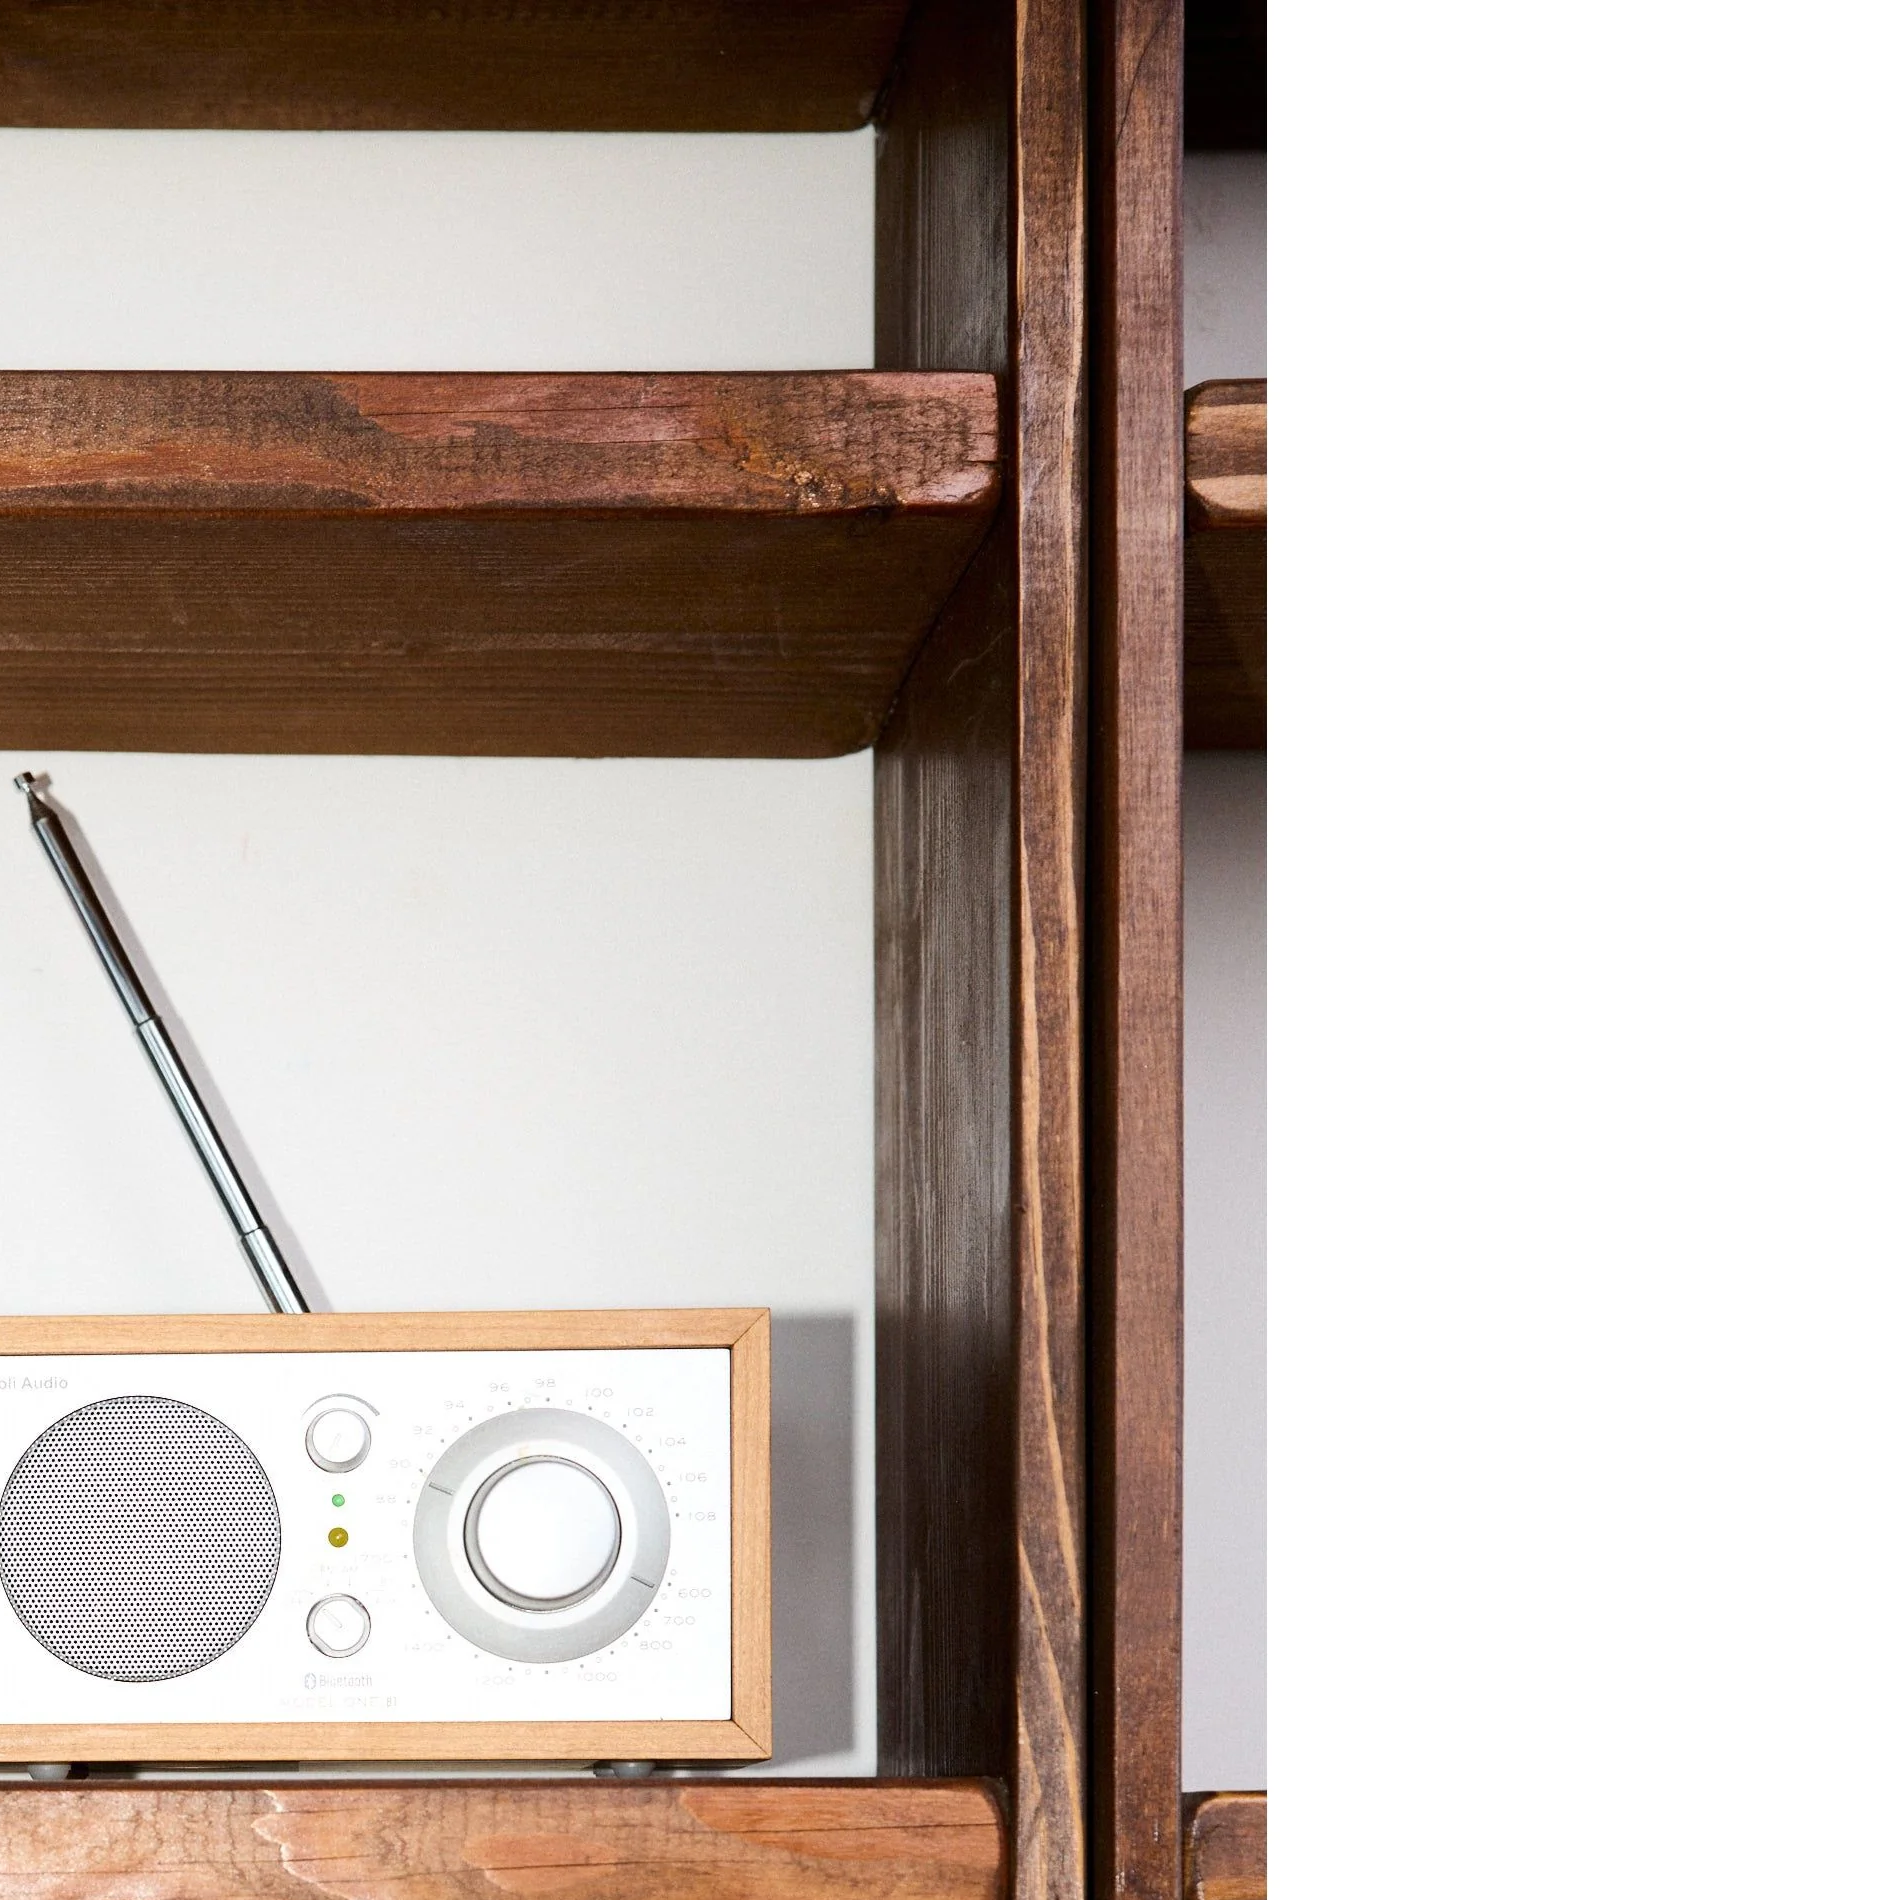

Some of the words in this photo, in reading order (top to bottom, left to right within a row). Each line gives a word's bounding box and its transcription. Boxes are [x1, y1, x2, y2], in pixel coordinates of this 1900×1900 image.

[21, 1376, 69, 1390] Audio
[535, 1378, 557, 1389] 98
[585, 1387, 614, 1399] 100
[627, 1407, 655, 1418] 102
[659, 1437, 687, 1448] 104
[680, 1472, 708, 1483] 106
[688, 1510, 717, 1522] 108
[678, 1587, 713, 1599] 600
[663, 1615, 697, 1627] 700
[639, 1639, 673, 1651] 800
